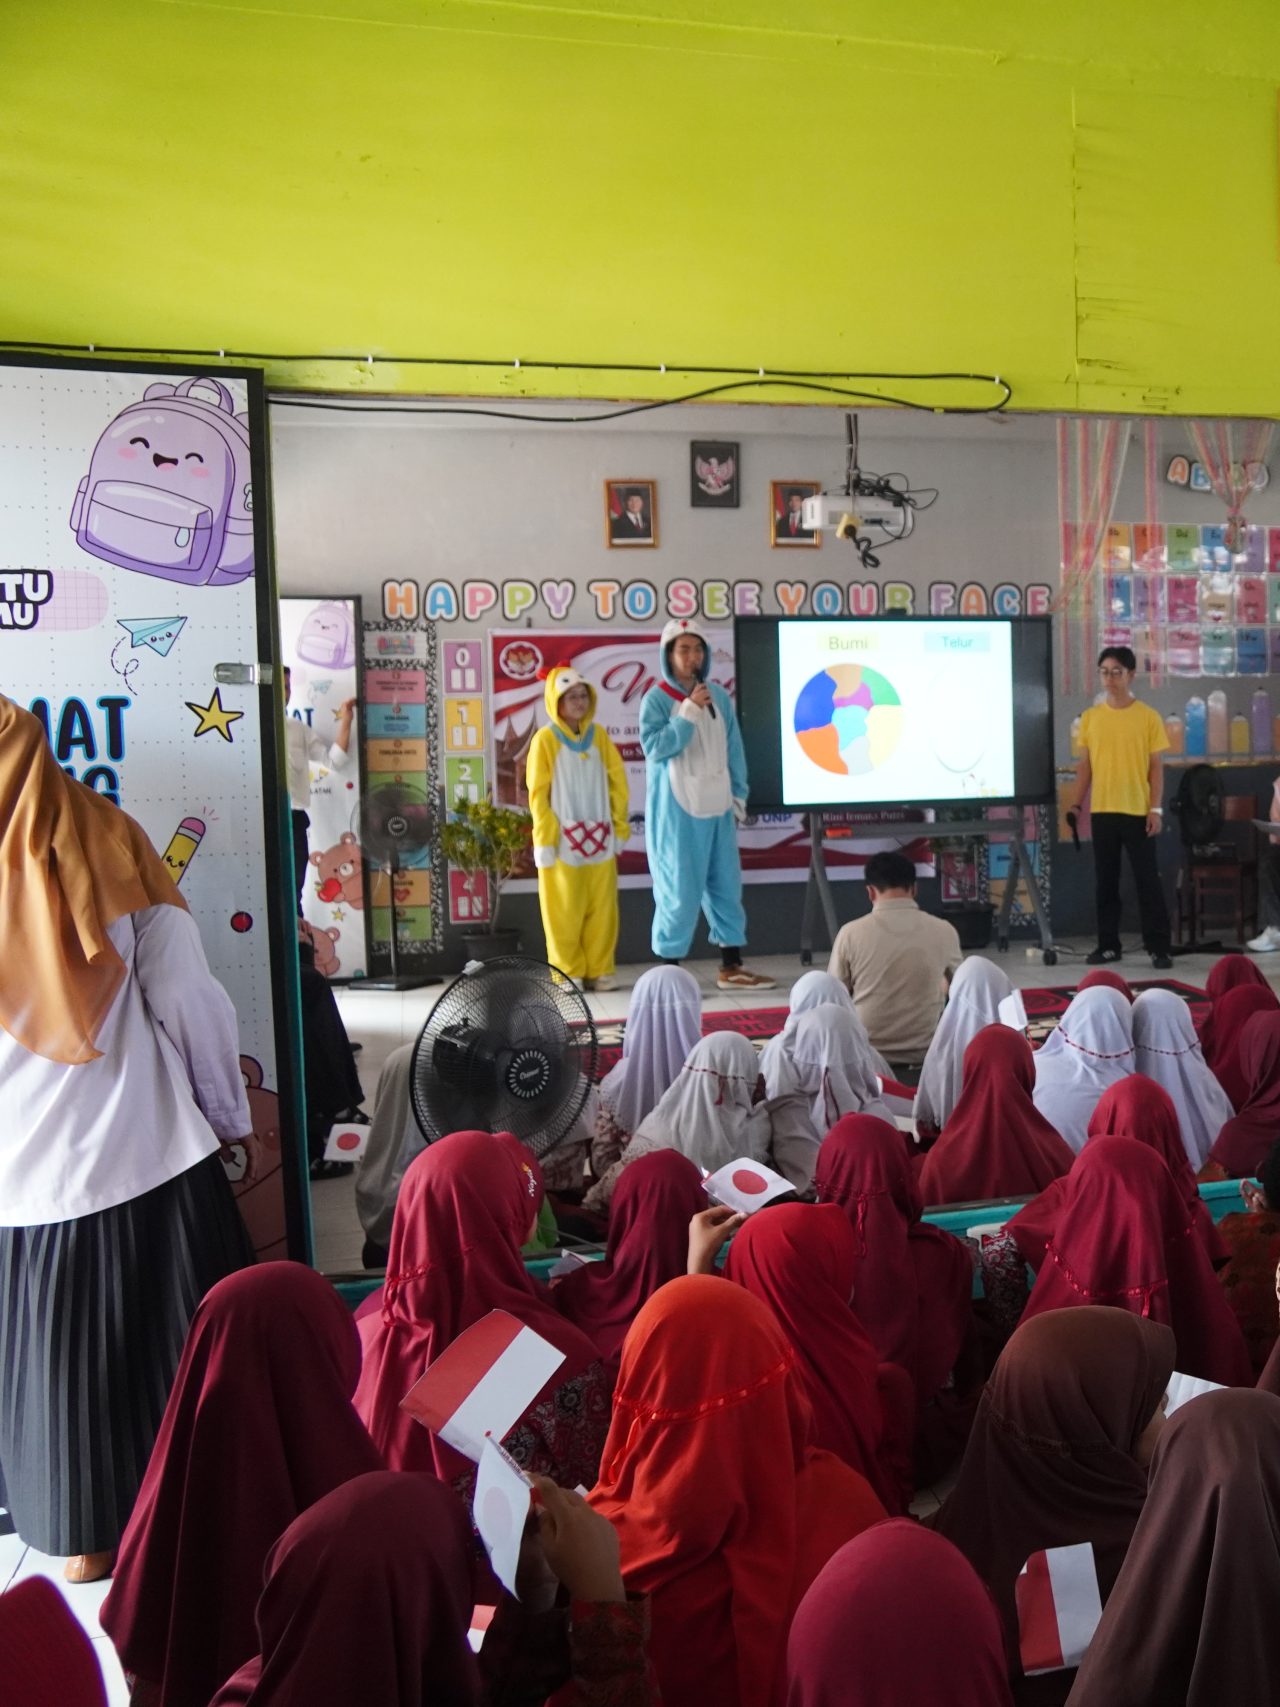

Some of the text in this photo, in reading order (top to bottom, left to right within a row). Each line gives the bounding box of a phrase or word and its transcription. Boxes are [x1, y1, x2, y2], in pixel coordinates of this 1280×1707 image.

[383, 581, 1051, 620] HAPPY TO SEE YOUR FACE
[828, 636, 869, 651] Bumi
[941, 635, 975, 649] Telur
[455, 648, 470, 667] 0
[457, 706, 467, 725] 1
[606, 725, 620, 736] to
[459, 763, 472, 782] 2
[762, 812, 792, 824] UNP
